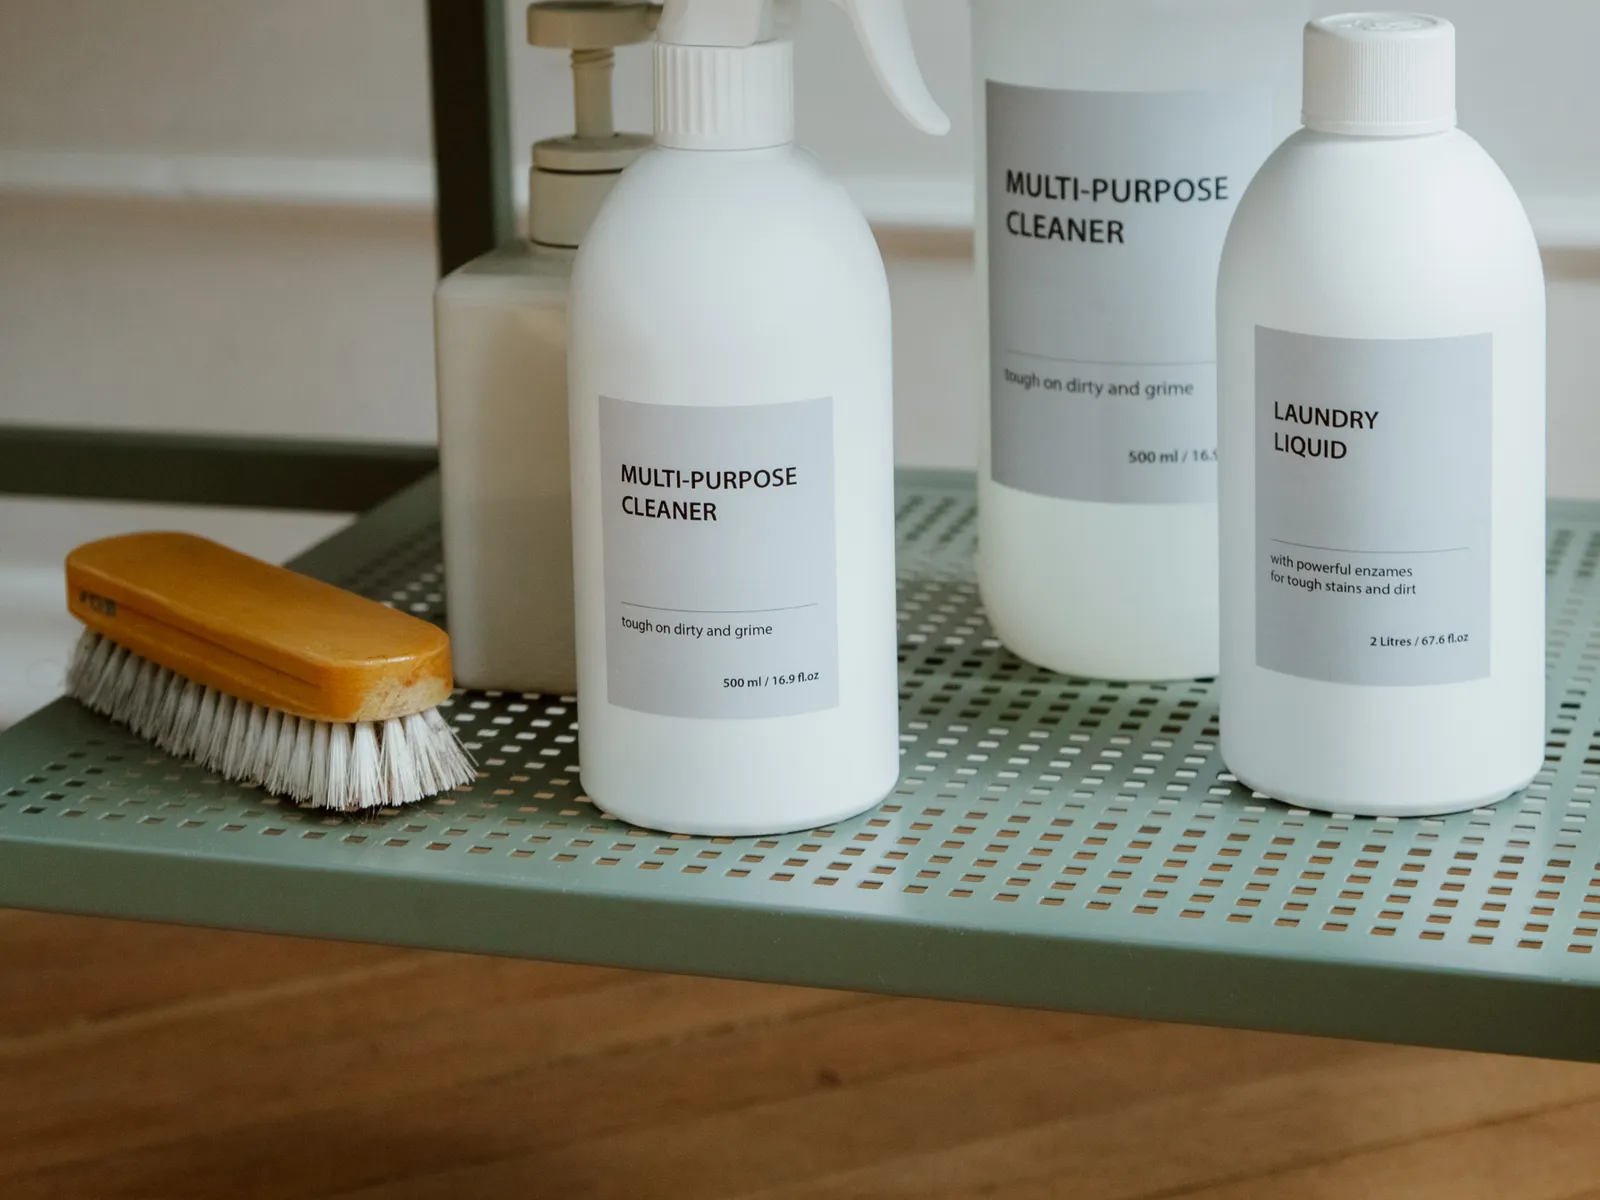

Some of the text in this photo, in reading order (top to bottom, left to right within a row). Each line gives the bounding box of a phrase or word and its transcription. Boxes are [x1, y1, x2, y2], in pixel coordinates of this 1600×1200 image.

[1005, 167, 1230, 204] MULTI-PURPOSE
[1006, 210, 1125, 245] CLEANER
[1003, 366, 1194, 401] tough on dirty and grime
[1274, 401, 1379, 430] LAUNDRY
[1128, 450, 1157, 464] 500
[1159, 449, 1179, 464] ml
[1274, 431, 1348, 460] LIQUID
[621, 463, 798, 490] MULTI-PURPOSE
[621, 495, 718, 522] CLEANER
[1270, 554, 1413, 578] with powerful enzames
[1270, 568, 1417, 596] for tough stains and dirt
[621, 616, 773, 640] tough on dirty and grime
[1370, 633, 1469, 648] 2 Litres / 67.6 fl.oz
[723, 671, 819, 688] 500 ml / 16.9 fl.oz
